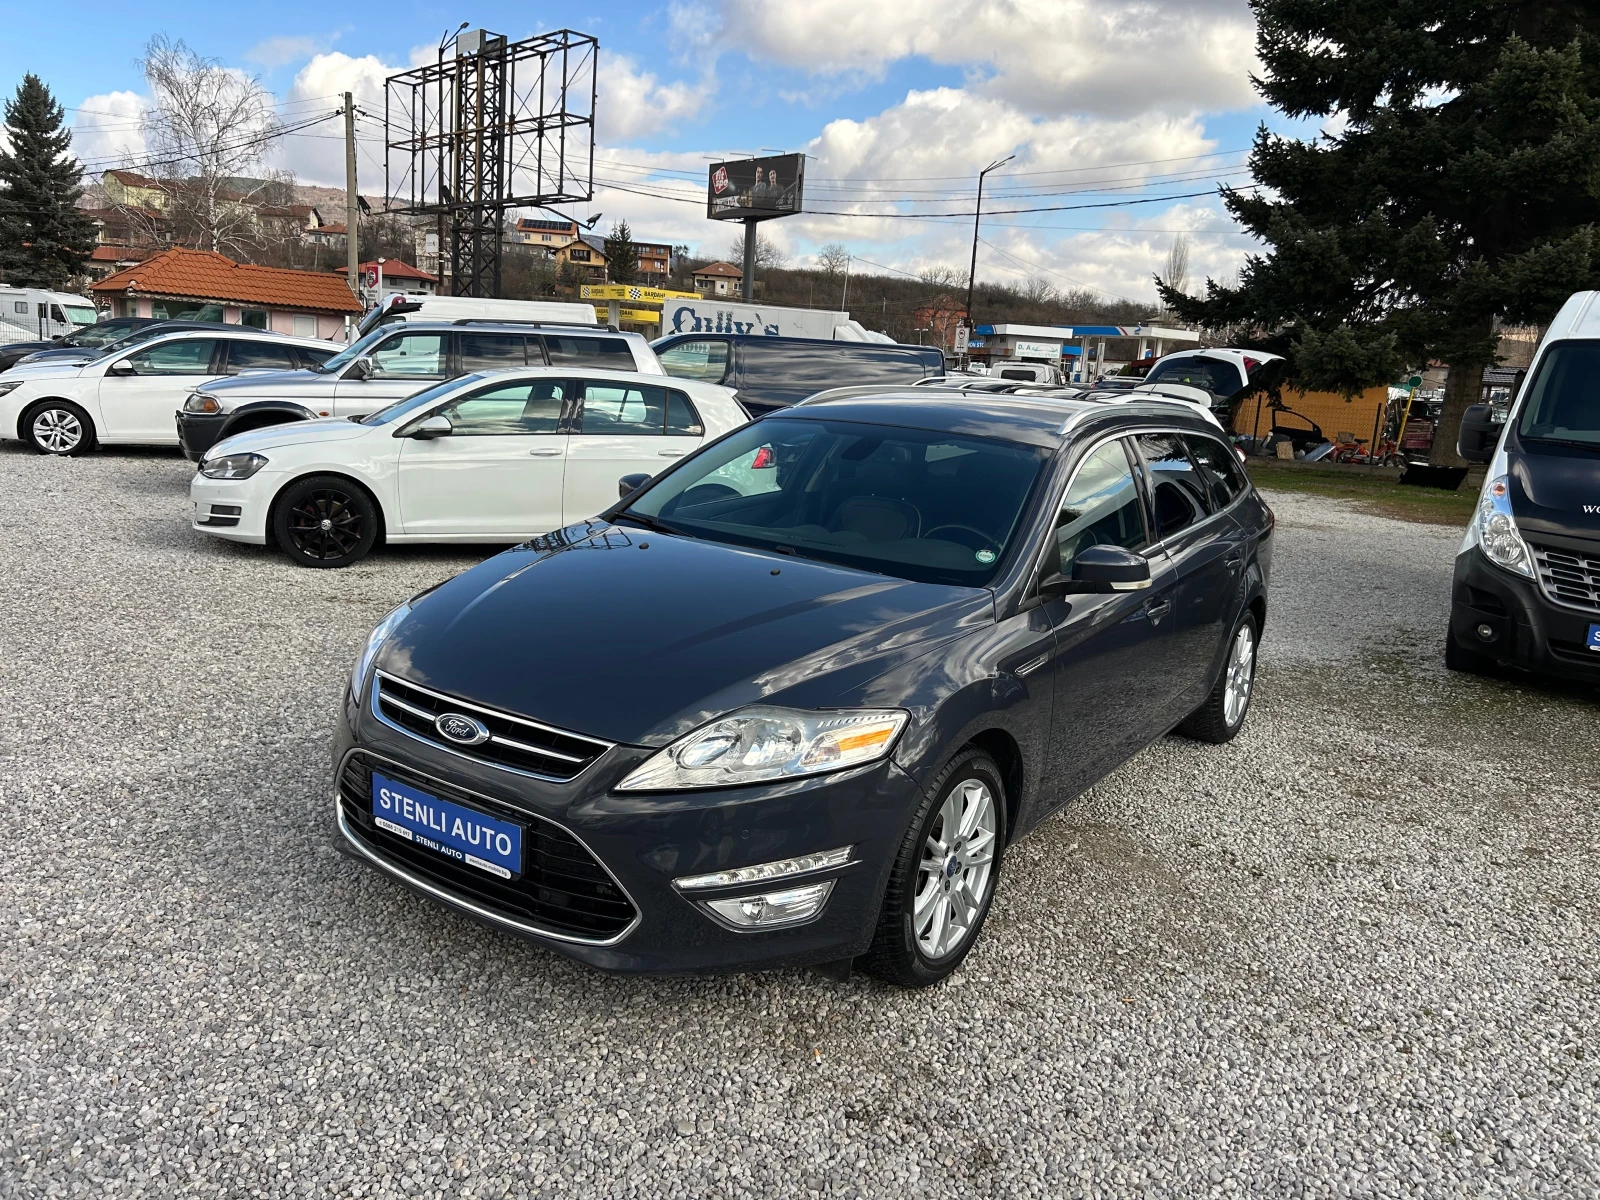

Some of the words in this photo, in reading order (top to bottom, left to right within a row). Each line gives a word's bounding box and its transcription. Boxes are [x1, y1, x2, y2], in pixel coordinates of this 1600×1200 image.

[445, 719, 470, 737] Ford
[379, 787, 446, 833] STENLI
[451, 817, 512, 856] AUTO
[415, 834, 439, 851] STENLI
[440, 845, 463, 859] AUTO
